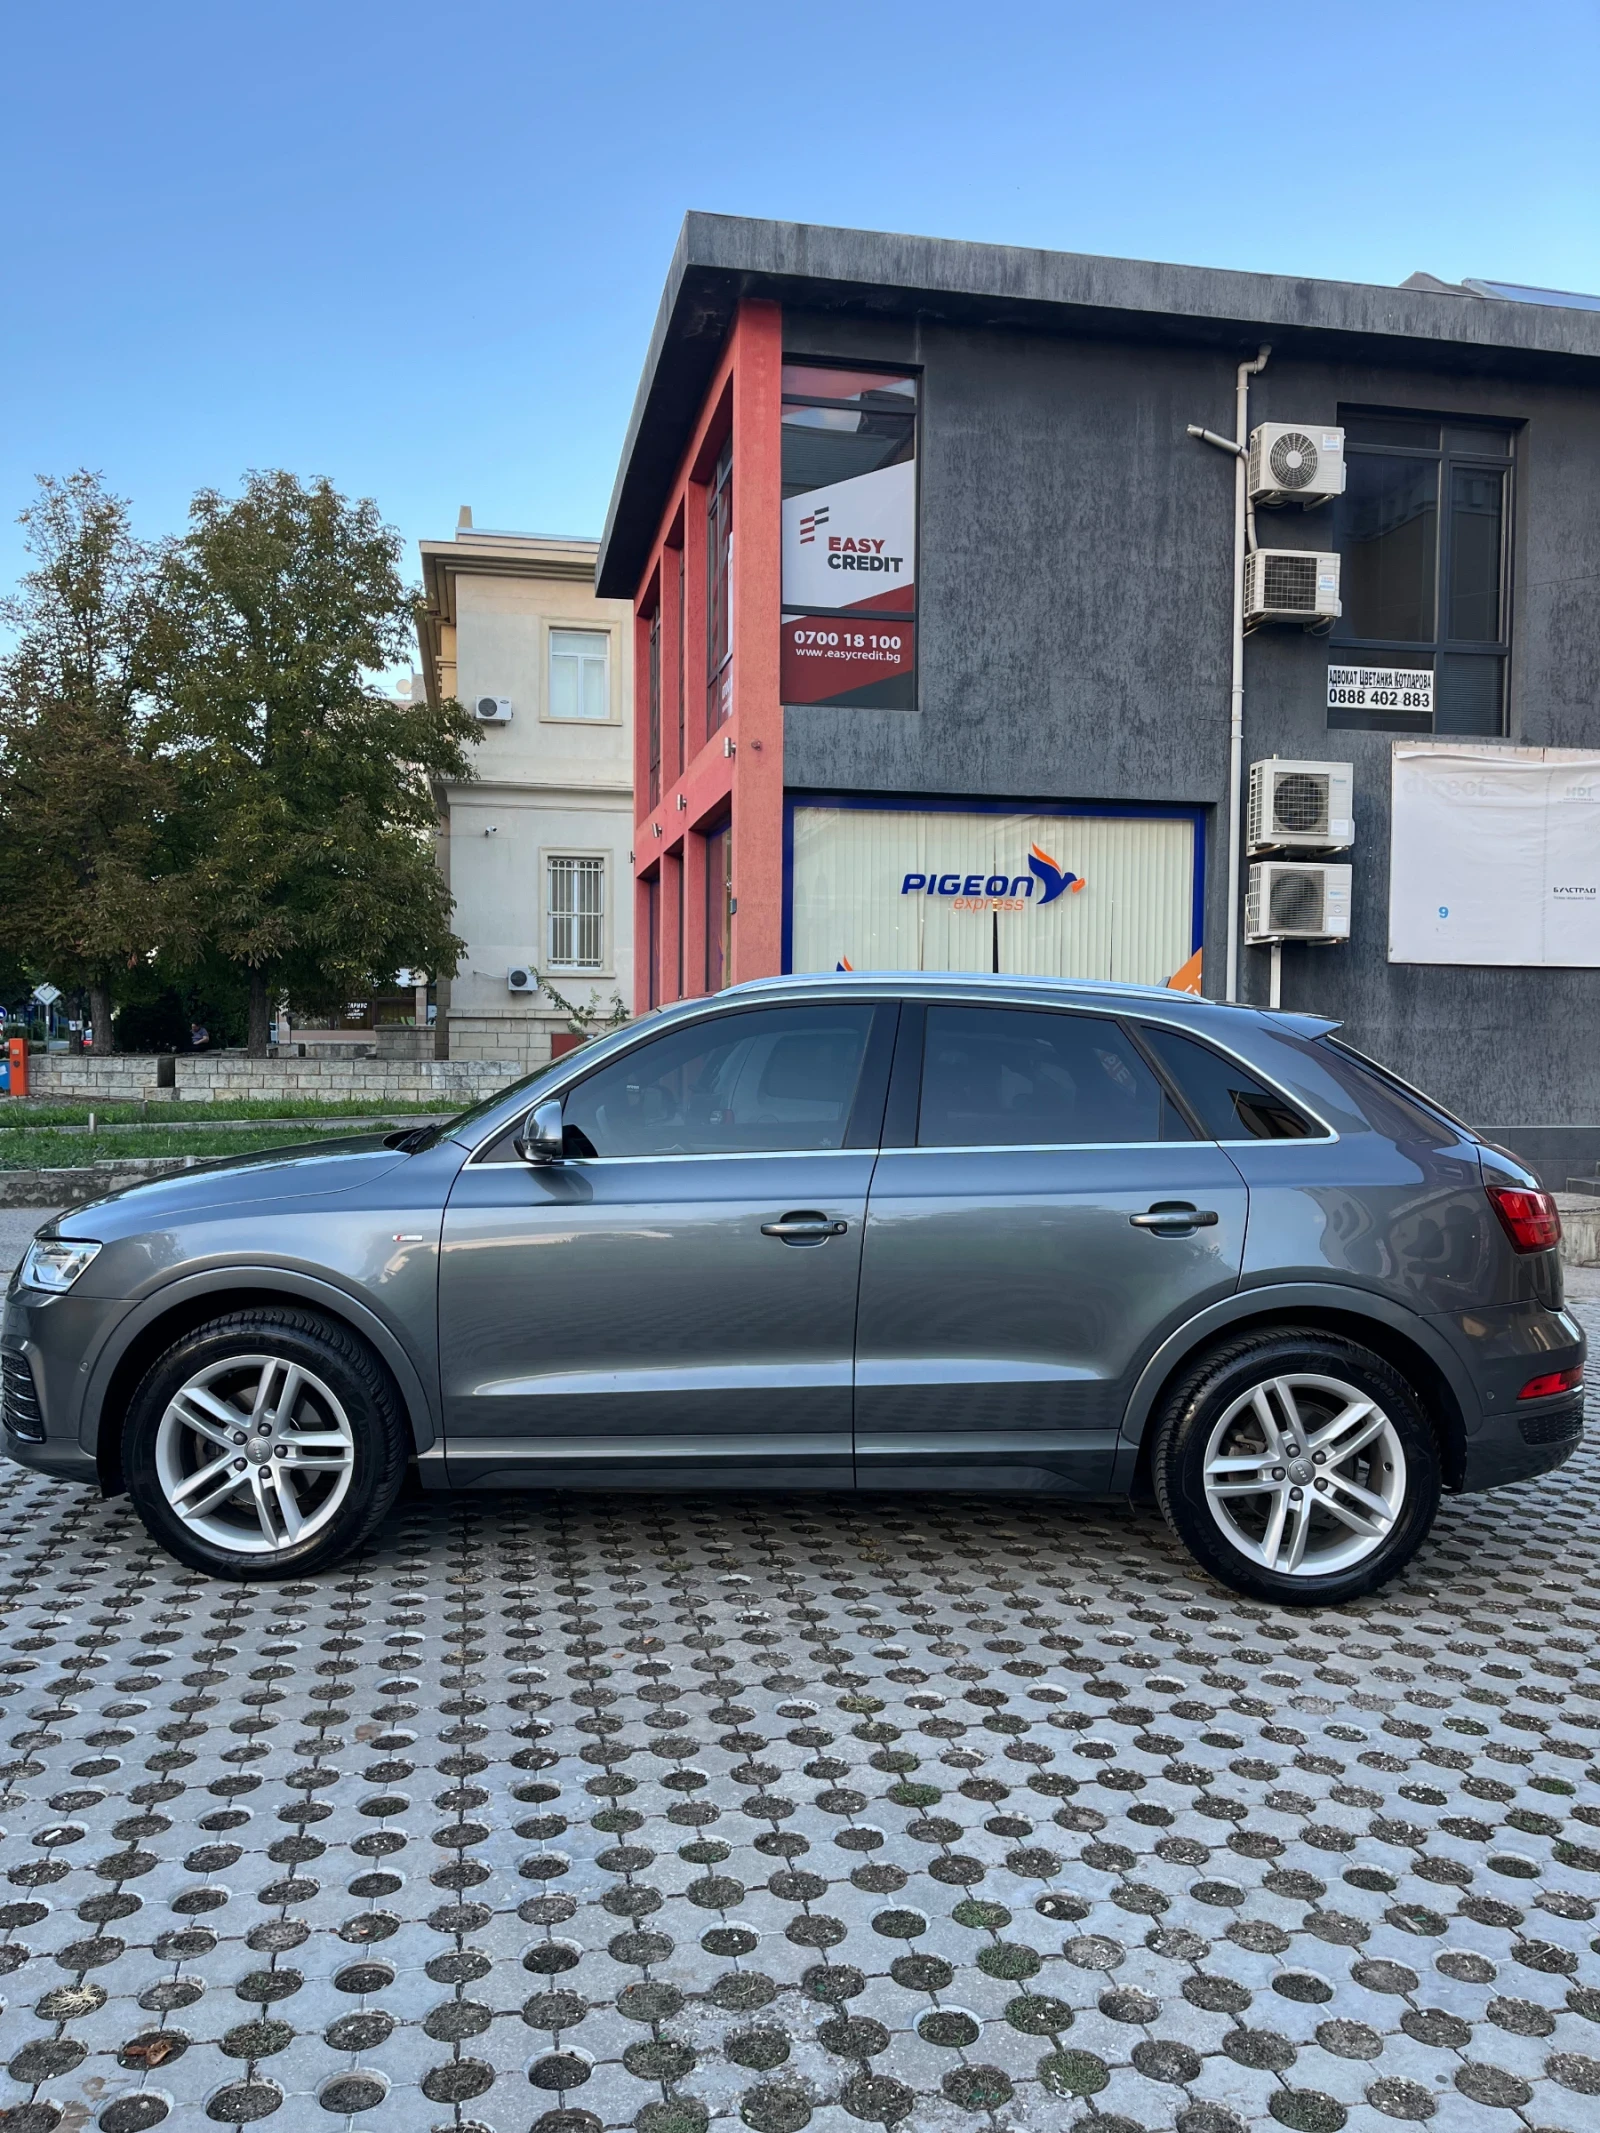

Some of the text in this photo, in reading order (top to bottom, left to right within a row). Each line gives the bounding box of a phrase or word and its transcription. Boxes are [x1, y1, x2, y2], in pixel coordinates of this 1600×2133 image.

[828, 536, 885, 554] EASY
[827, 553, 904, 573] CREDIT
[794, 630, 901, 650] 0700 18 100
[795, 648, 901, 663] www.easycredit.bg
[1329, 669, 1358, 687] АДВОКАТ
[1329, 688, 1430, 708] 0888 402 883
[953, 897, 1024, 914] express
[1438, 906, 1449, 919] 9
